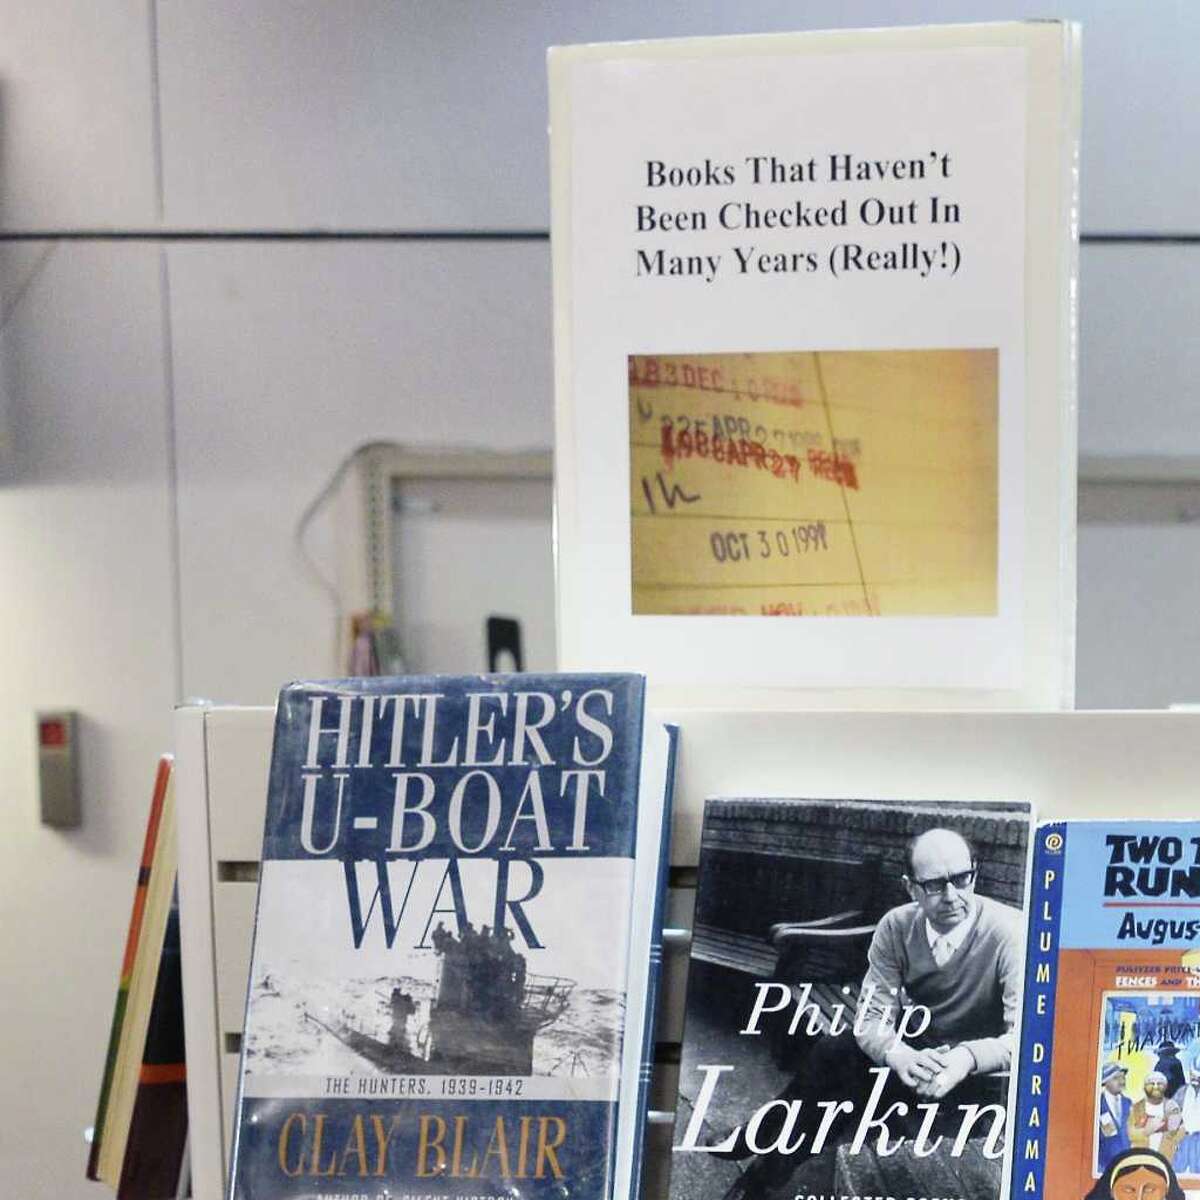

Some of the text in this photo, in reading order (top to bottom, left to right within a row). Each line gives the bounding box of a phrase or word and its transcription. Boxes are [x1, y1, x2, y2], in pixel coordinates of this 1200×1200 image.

[646, 151, 953, 188] Books That Haven't
[636, 197, 961, 233] Been Checked Out In
[635, 242, 962, 283] Many Years (Really!)
[710, 531, 751, 563] OCT
[302, 689, 614, 770] HITLER'S
[300, 769, 606, 854] U-BOAT
[1106, 834, 1183, 866] TWO
[342, 857, 546, 950] WAR
[1036, 869, 1056, 1016] PLUME
[739, 982, 932, 1054] Philip
[326, 1077, 349, 1094] THE
[441, 1079, 524, 1096] 1939-1942
[673, 1064, 1006, 1161] Larkin
[1024, 1042, 1044, 1193] DRAMA
[277, 1111, 567, 1181] CLAY BLAIR
